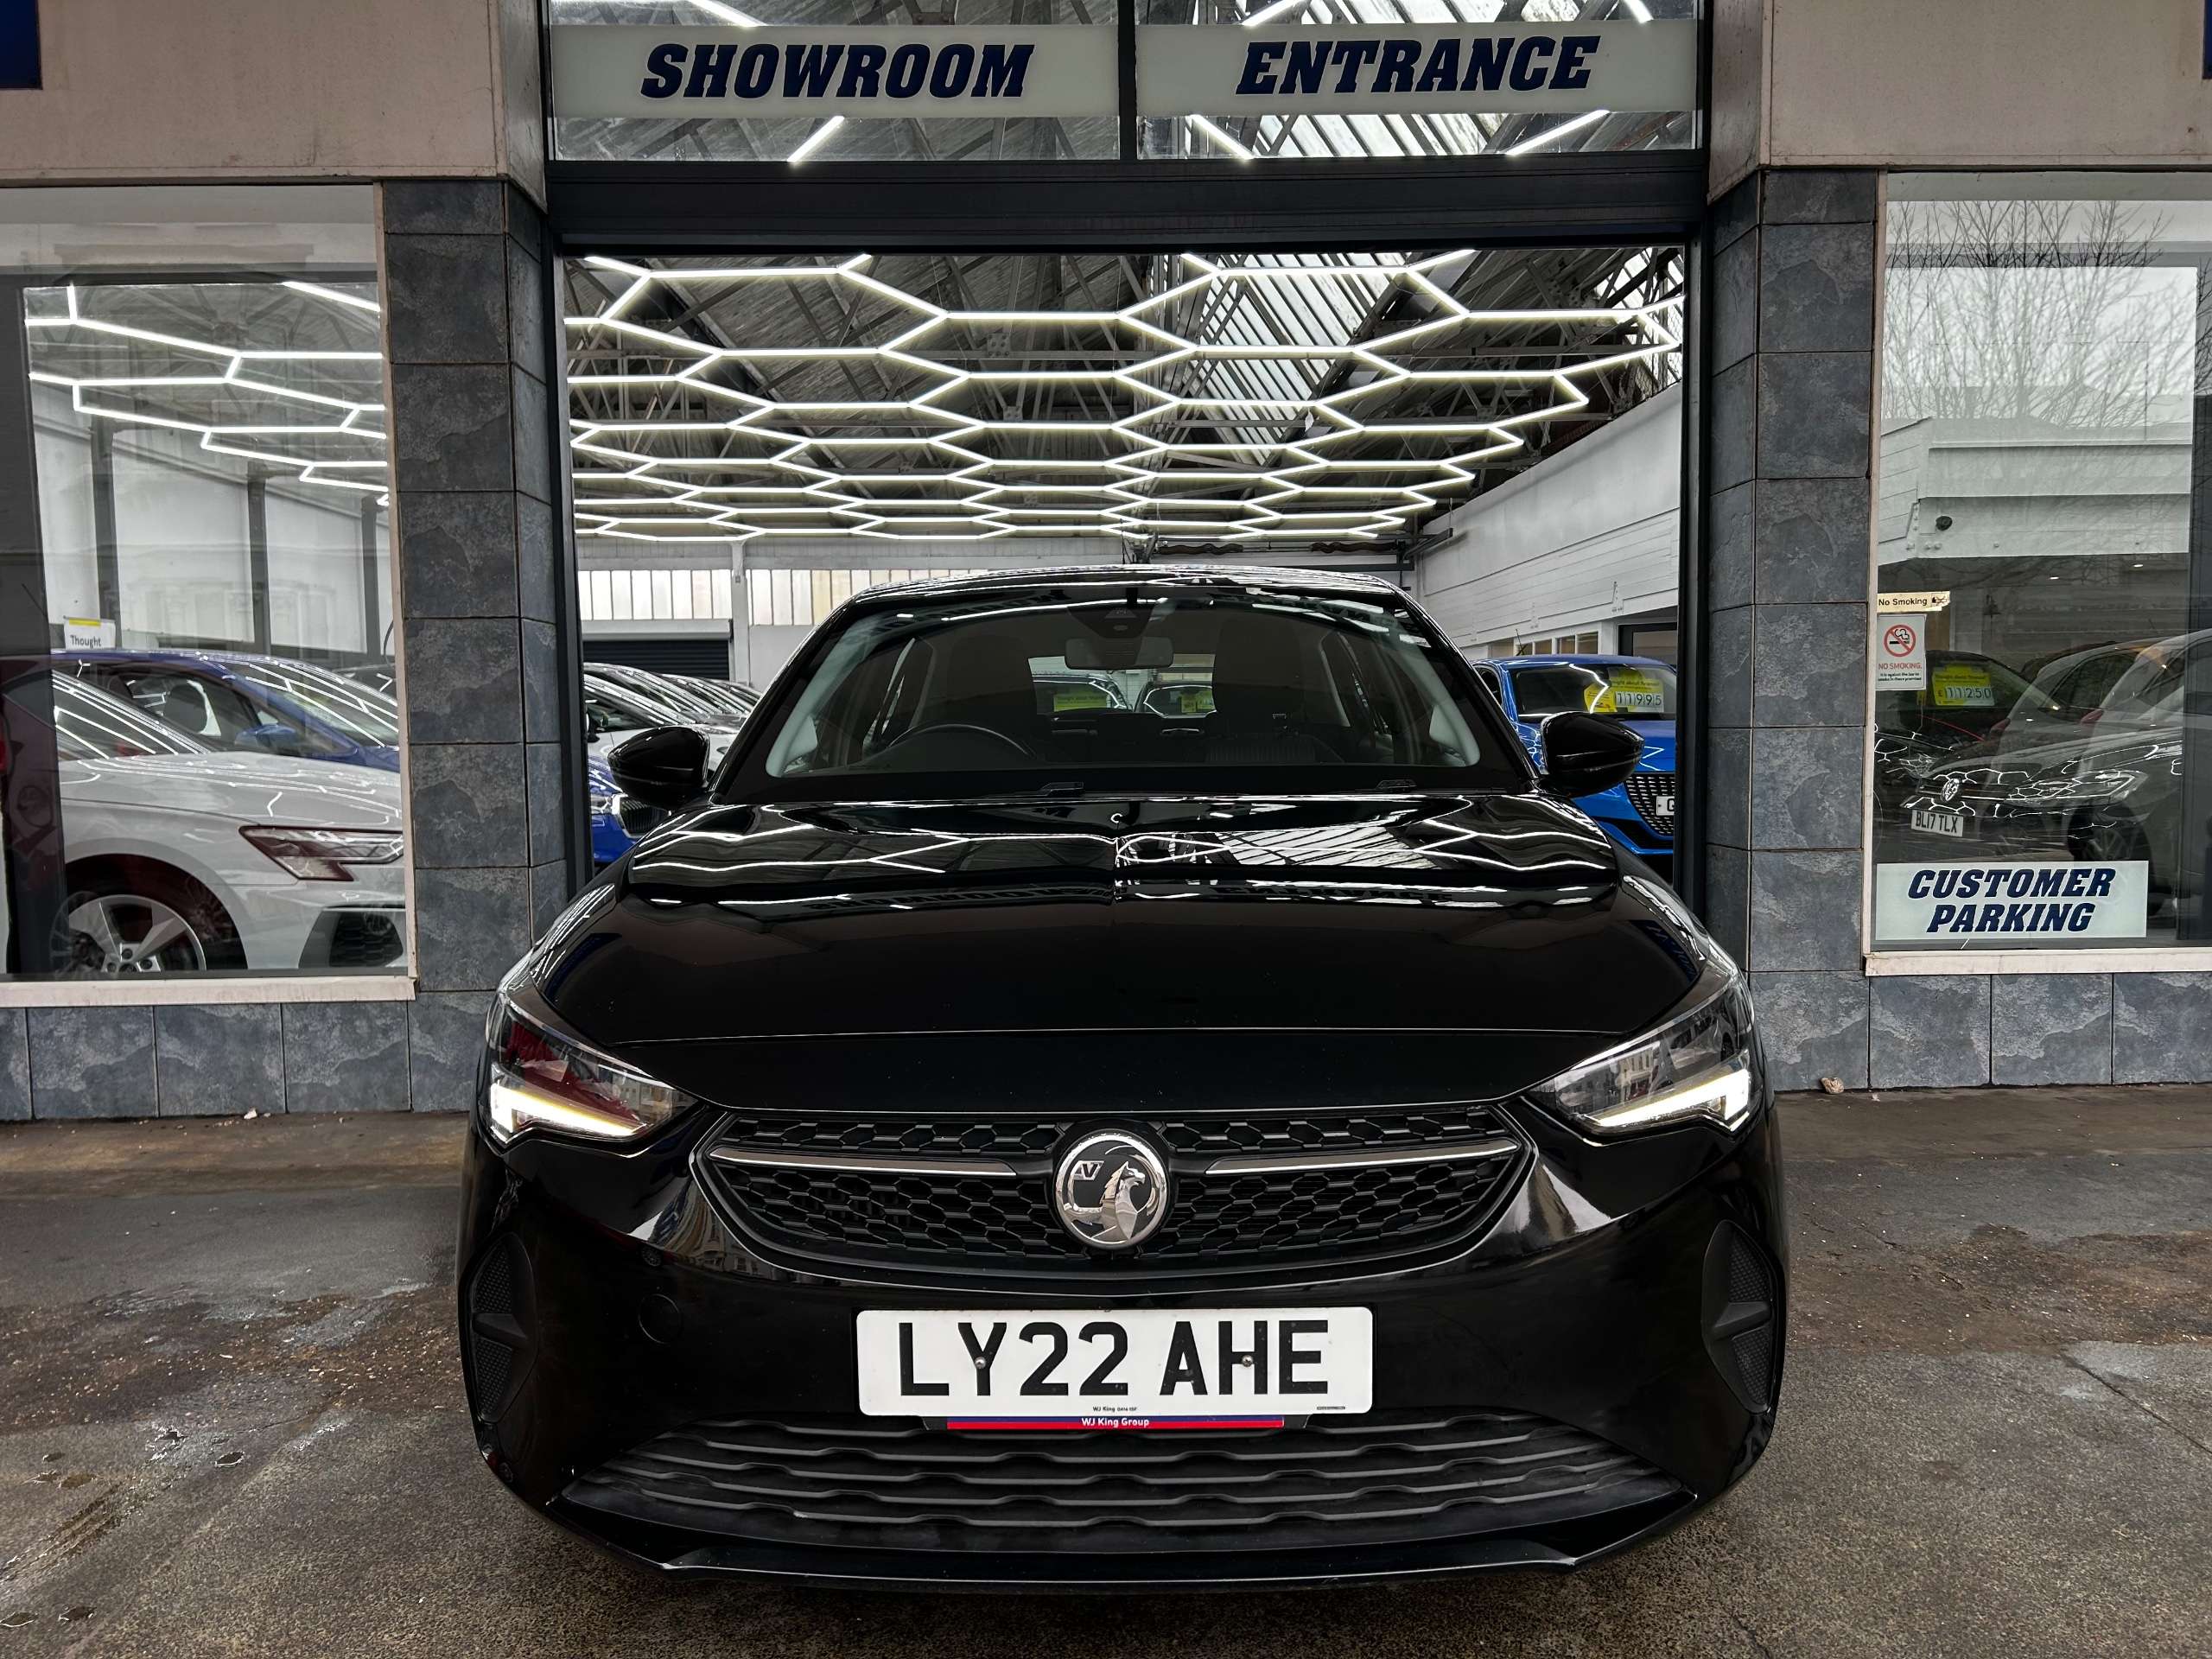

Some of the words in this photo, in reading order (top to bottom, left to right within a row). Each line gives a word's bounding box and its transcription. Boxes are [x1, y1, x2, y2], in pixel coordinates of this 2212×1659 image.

[641, 43, 1035, 99] SHOWROOM
[1235, 35, 1601, 95] ENTRANCE
[1892, 598, 1928, 607] Smoking
[70, 634, 101, 649] Thought
[1617, 692, 1662, 706] 11995
[1916, 810, 1936, 830] BL17
[1938, 814, 1958, 834] TLX
[1908, 868, 2116, 899] CUSTOMER
[1926, 902, 2096, 933] PARKING
[899, 1322, 1128, 1396] LY22
[1159, 1319, 1329, 1395] AHE
[1081, 1417, 1096, 1427] WJ
[1097, 1417, 1119, 1428] King
[1121, 1417, 1150, 1428] Group
